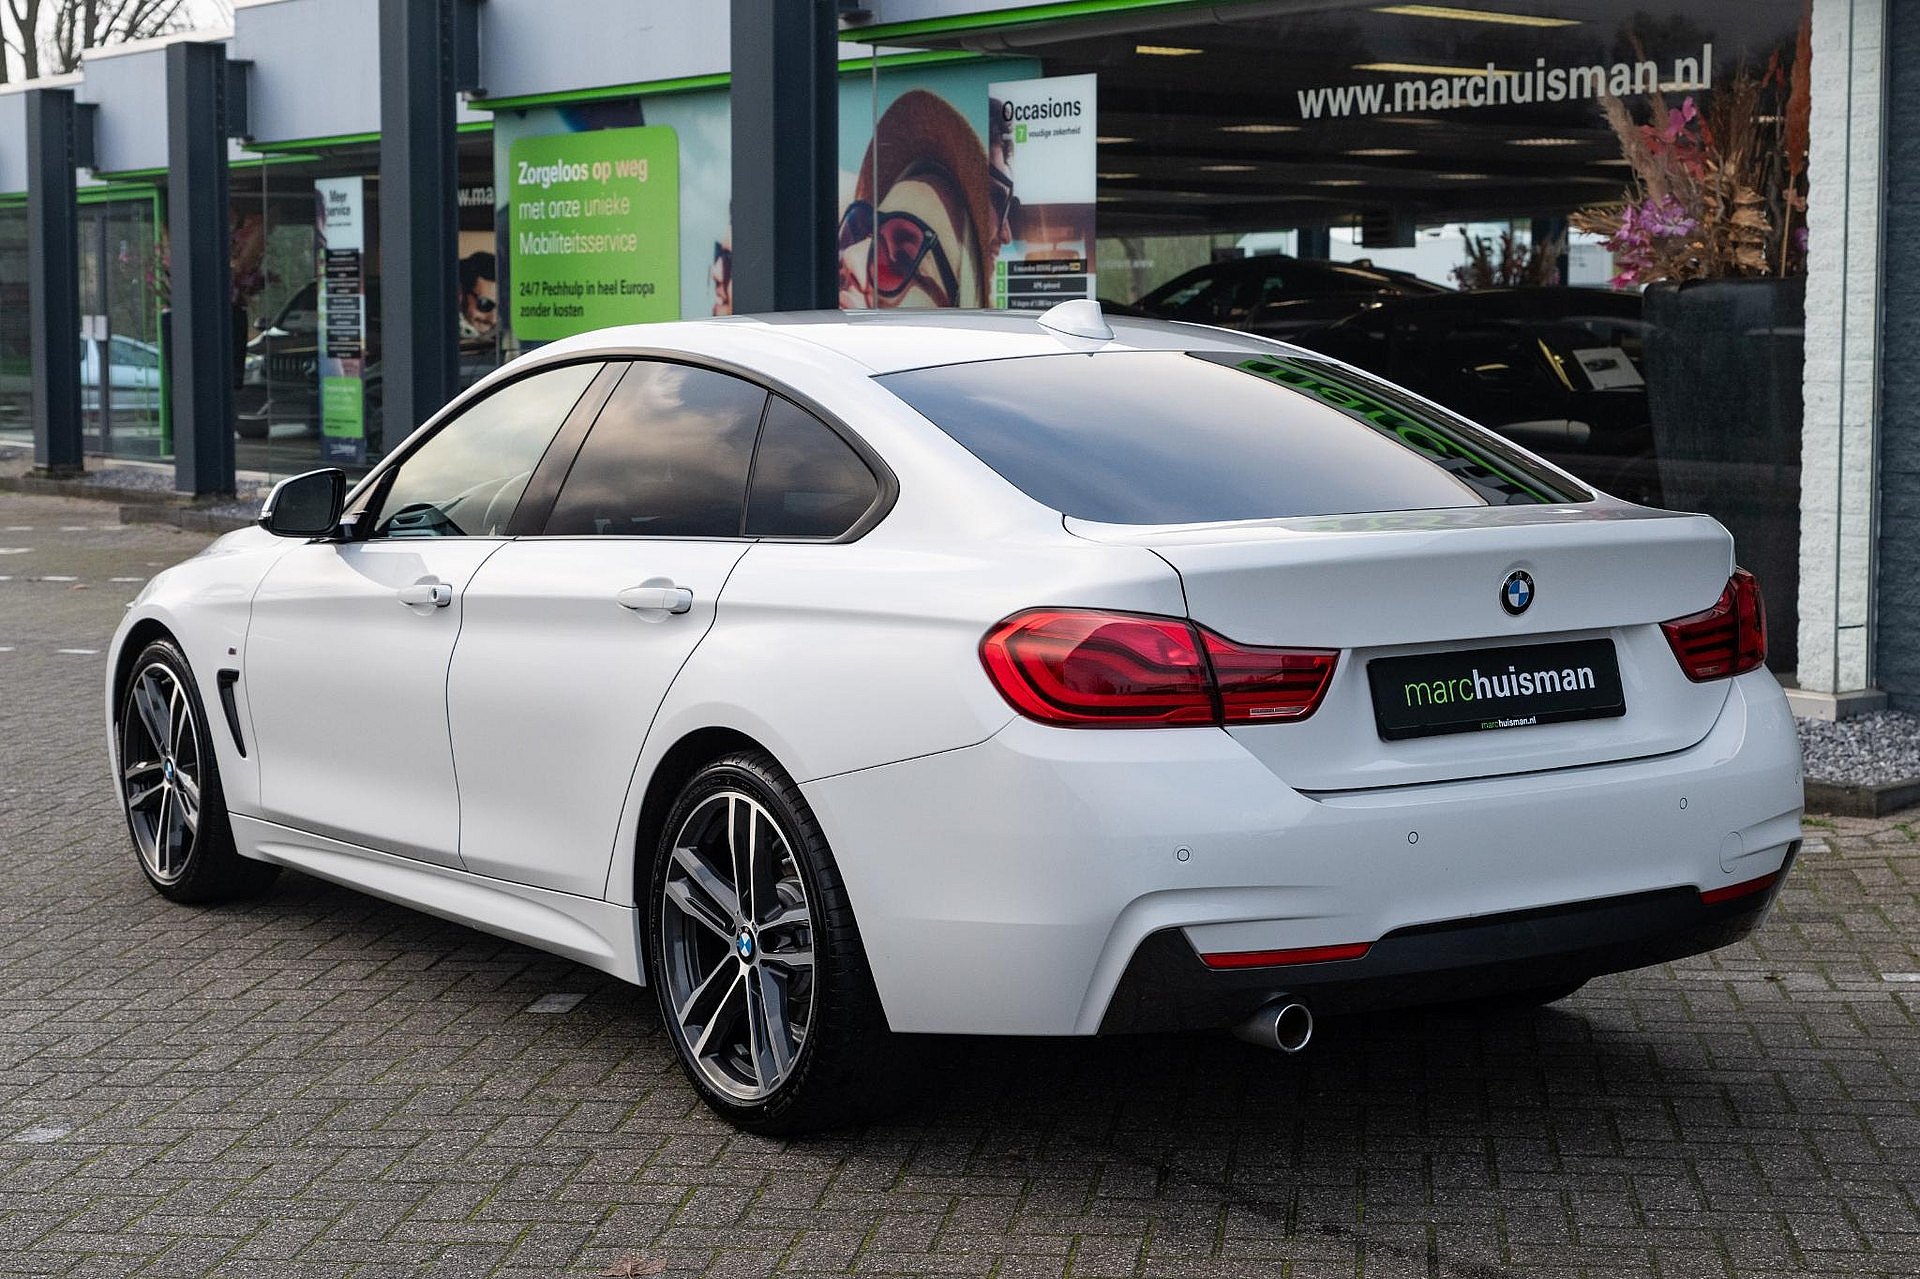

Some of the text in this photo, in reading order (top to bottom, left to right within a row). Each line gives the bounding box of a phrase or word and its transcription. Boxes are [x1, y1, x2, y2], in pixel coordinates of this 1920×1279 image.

[1297, 43, 1713, 120] www.marchuisman.nl
[1002, 97, 1081, 122] Occasions
[1028, 128, 1052, 139] voudige
[1053, 126, 1081, 137] zekerheid
[517, 158, 649, 189] Zorgeloos op weg
[518, 192, 630, 220] met onze unieke
[519, 228, 638, 256] Mobiliteitsservice
[519, 279, 655, 300] 24/7 Pechhulp in heel Europa
[519, 302, 585, 318] zonder kosten
[1404, 665, 1596, 707] marchuisman
[1481, 715, 1537, 729] marchuisman.nl
